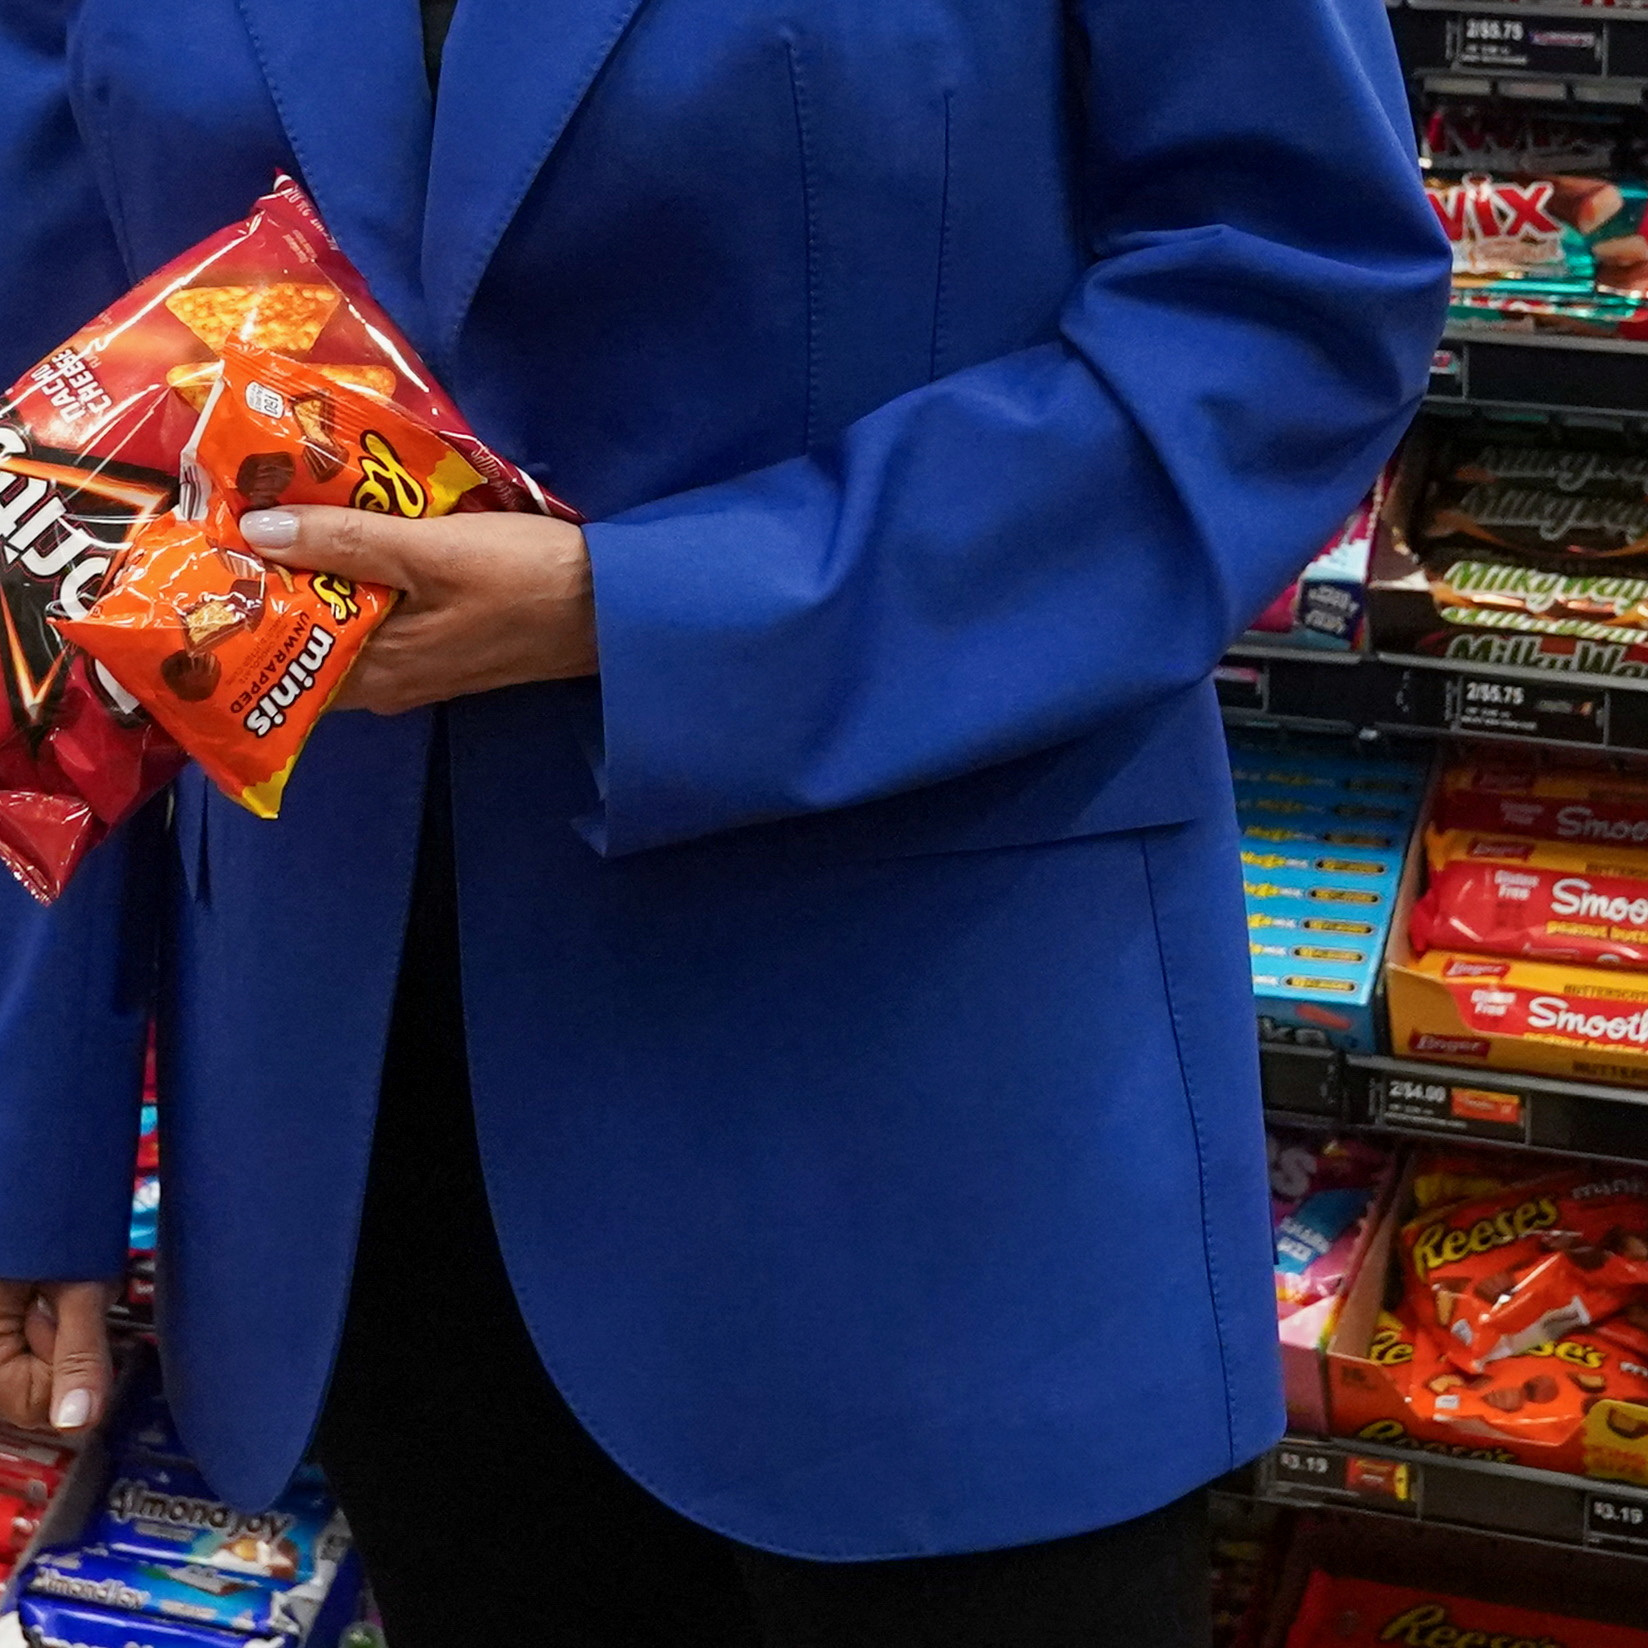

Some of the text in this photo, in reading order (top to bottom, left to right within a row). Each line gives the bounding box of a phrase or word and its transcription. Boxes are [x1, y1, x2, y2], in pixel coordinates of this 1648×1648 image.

[230, 610, 310, 713] UNWRAPPED
[243, 624, 337, 738] minis
[1545, 921, 1606, 940] peanut
[1413, 1194, 1558, 1281] Reese's
